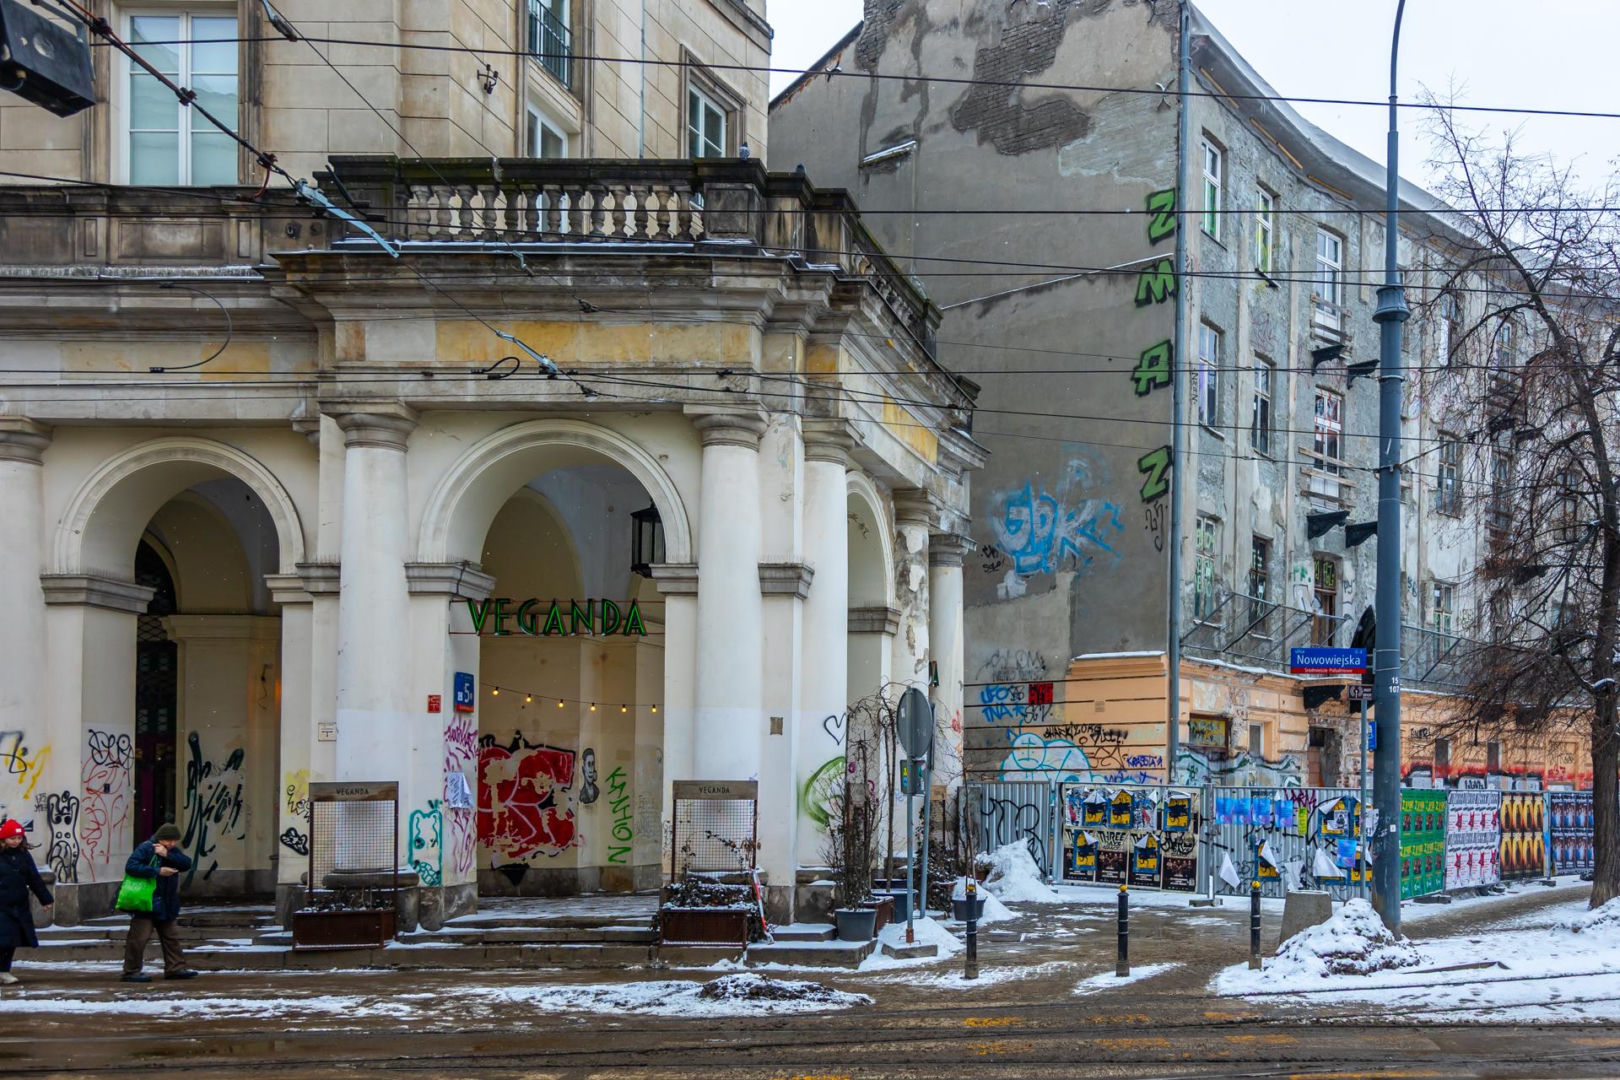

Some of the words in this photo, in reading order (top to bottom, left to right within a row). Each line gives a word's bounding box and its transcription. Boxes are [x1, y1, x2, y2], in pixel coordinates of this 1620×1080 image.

[467, 598, 647, 636] VEGANDA
[1296, 654, 1361, 667] Nowowiejska
[464, 682, 470, 703] 5
[335, 787, 369, 795] VEGANDA
[699, 786, 730, 794] VEGANDA
[1097, 830, 1127, 844] THREE
